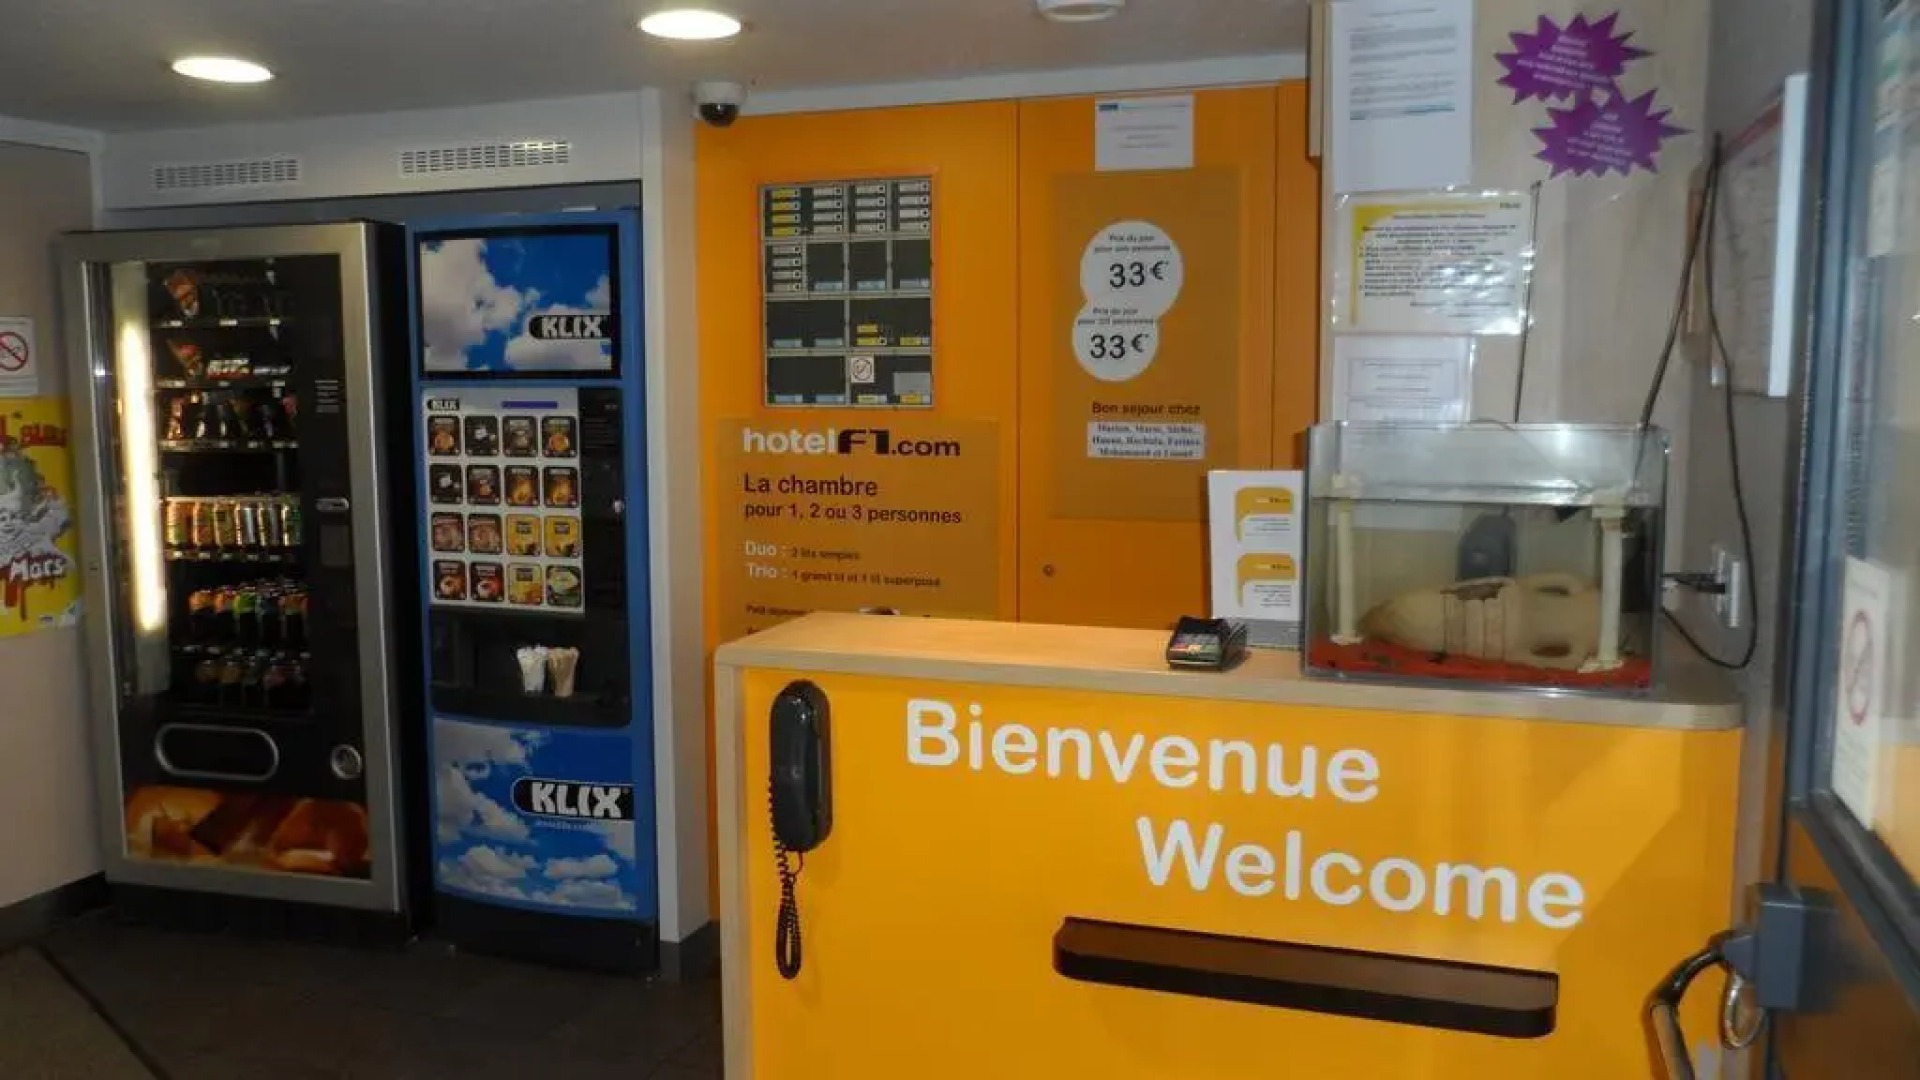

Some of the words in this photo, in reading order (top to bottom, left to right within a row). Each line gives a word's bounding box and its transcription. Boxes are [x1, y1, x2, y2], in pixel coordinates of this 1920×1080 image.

[541, 316, 602, 338] KLIX
[1092, 401, 1118, 413] Bon
[744, 472, 771, 493] La
[777, 473, 878, 496] chambre
[745, 503, 782, 521] pour
[788, 503, 804, 520] 1,
[809, 502, 821, 519] 2
[824, 506, 846, 520] ou
[852, 503, 861, 520] 3
[867, 507, 961, 525] personnes
[745, 540, 777, 557] Duo
[747, 562, 777, 578] Trio
[906, 698, 1380, 804] Bienvenue
[530, 781, 622, 819] KLIX
[1136, 814, 1585, 930] Welcome
